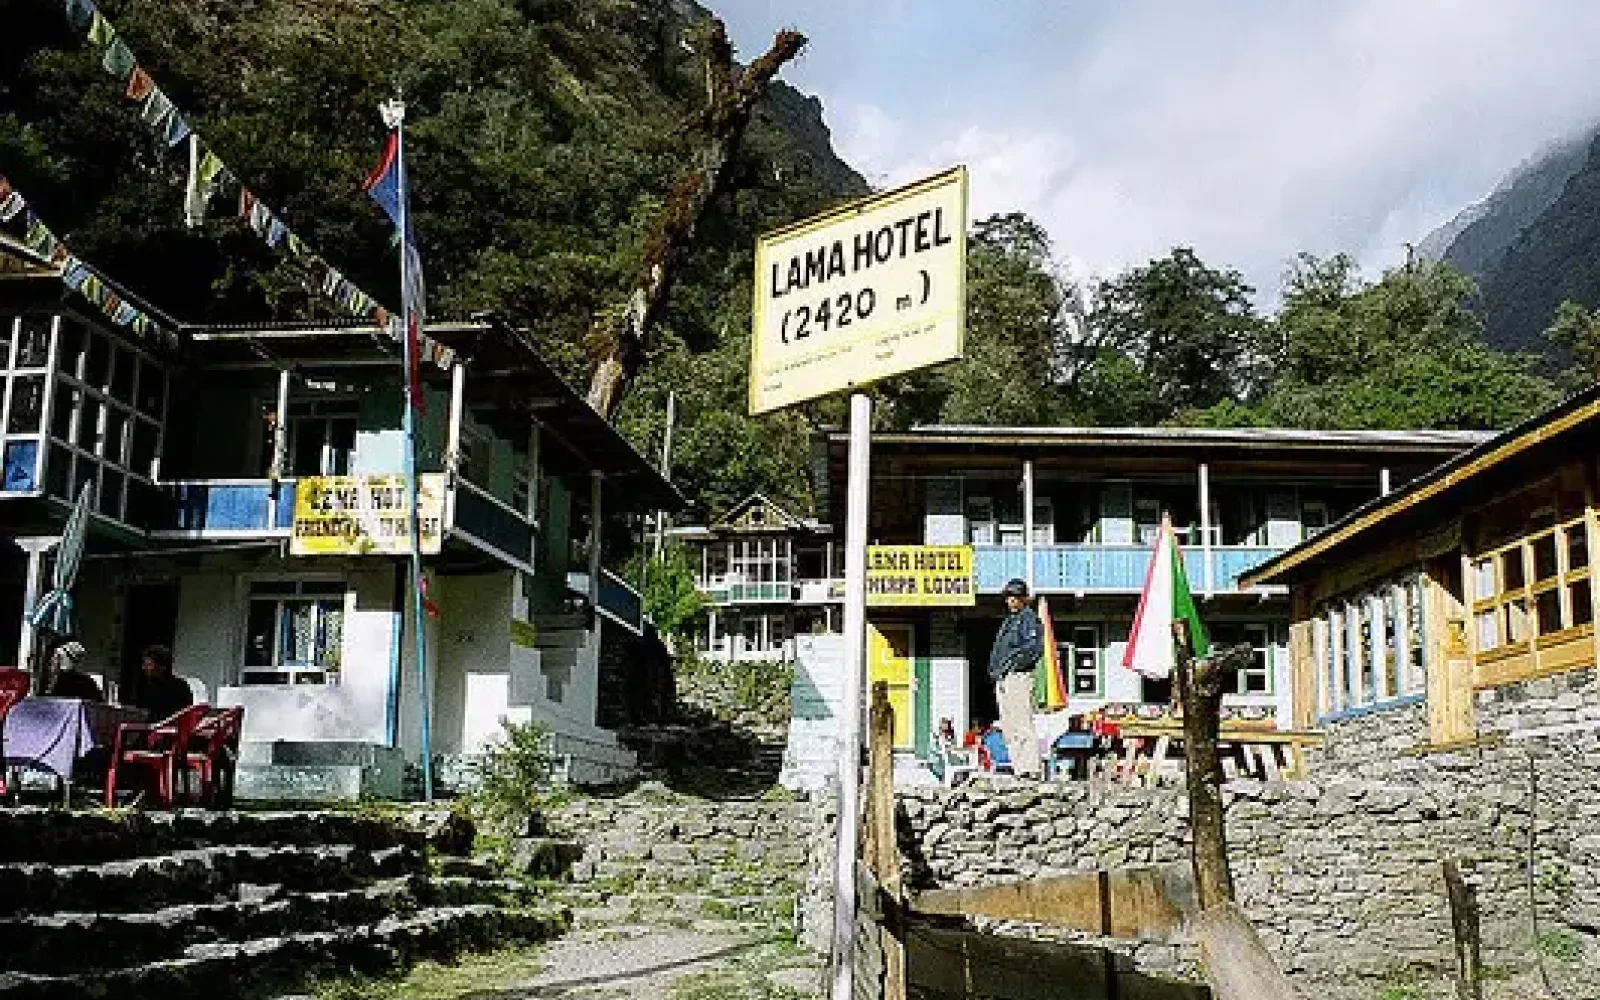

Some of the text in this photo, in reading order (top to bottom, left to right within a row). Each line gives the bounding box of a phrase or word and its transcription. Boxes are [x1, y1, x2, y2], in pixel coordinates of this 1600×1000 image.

[772, 206, 952, 298] LAMA HOTEL
[914, 550, 964, 572] HOTEL
[867, 576, 971, 594] HERPA LODGE
